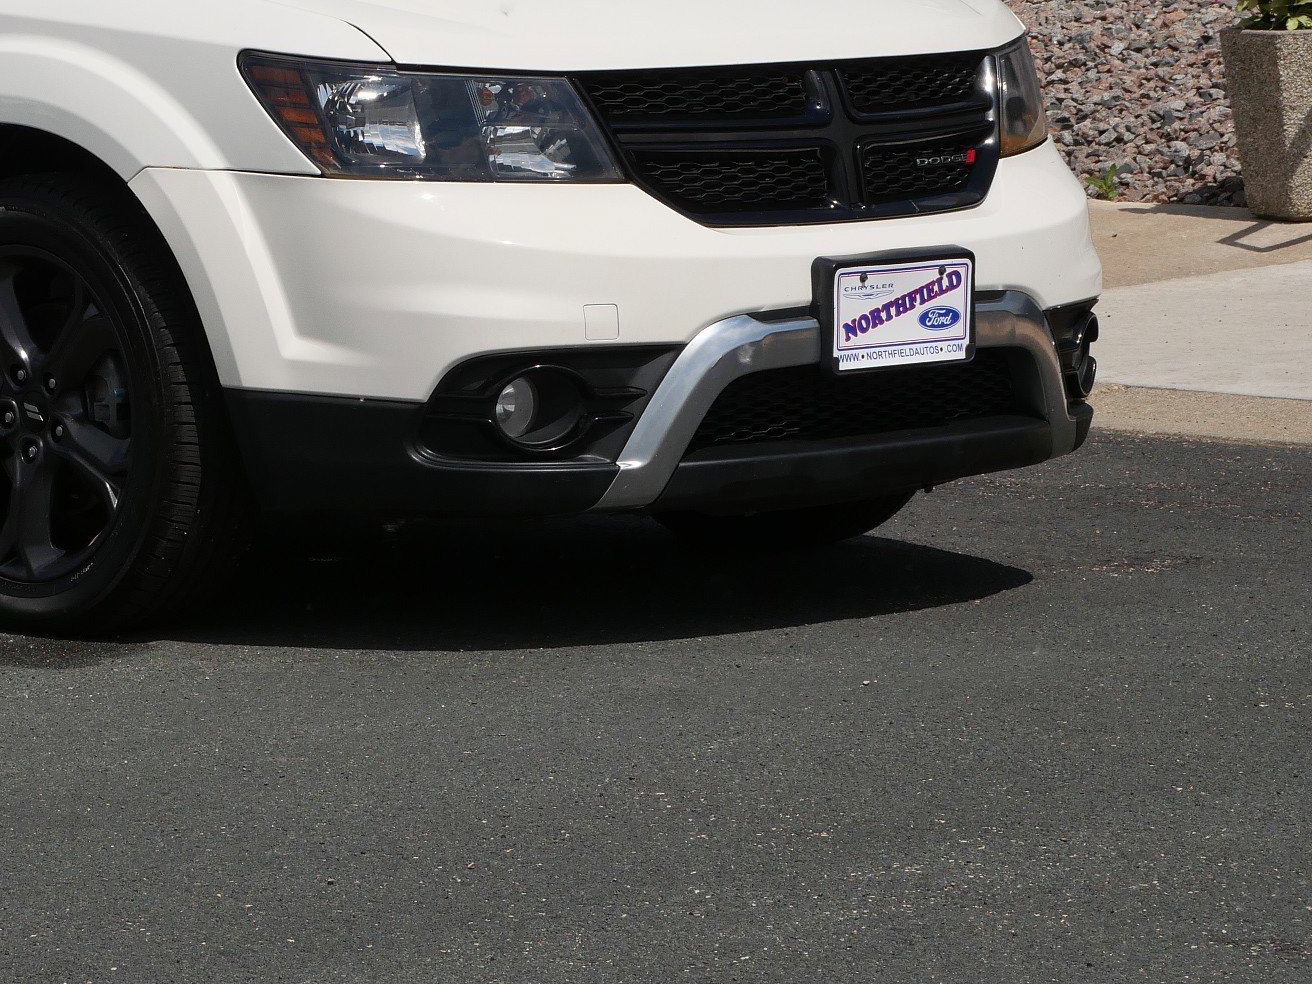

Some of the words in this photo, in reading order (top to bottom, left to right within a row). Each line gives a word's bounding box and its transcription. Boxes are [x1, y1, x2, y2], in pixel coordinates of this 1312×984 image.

[843, 283, 894, 293] CHRYSLER
[842, 269, 962, 342] NORTHFIELD
[925, 309, 953, 326] Ford
